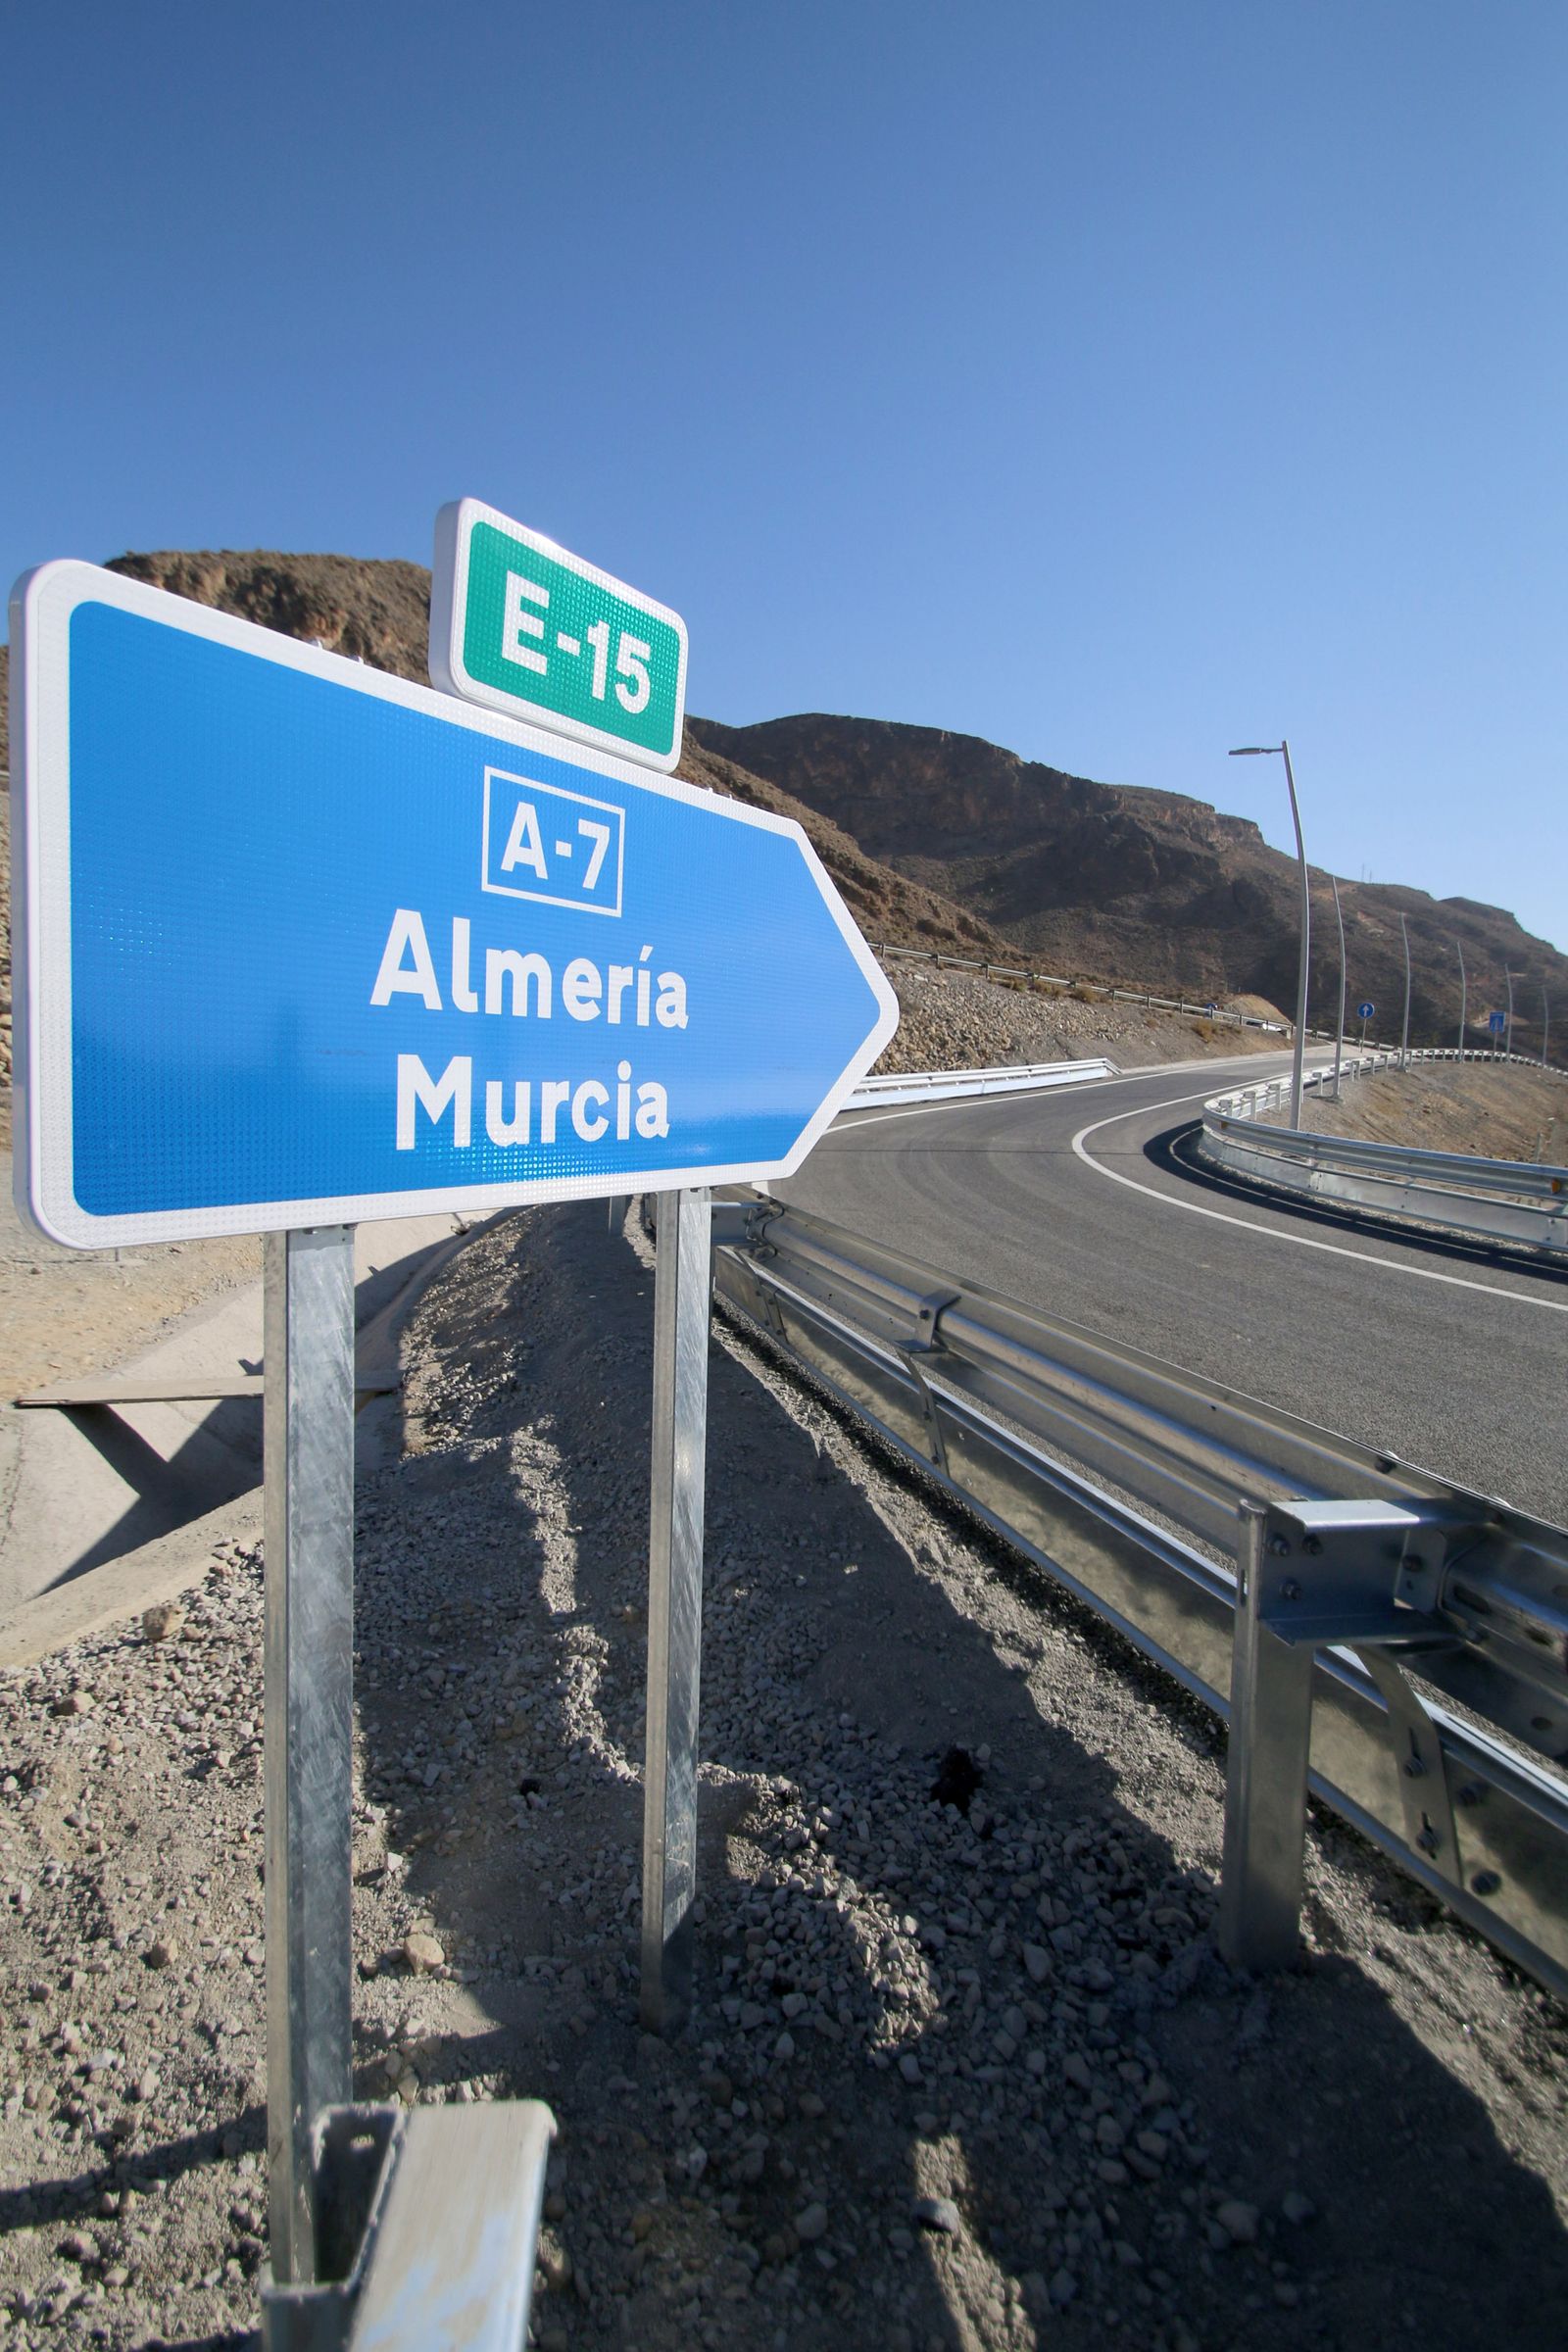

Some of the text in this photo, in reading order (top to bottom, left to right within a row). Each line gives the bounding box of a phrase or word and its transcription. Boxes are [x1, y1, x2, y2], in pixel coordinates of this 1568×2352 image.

[502, 570, 652, 714] E-15
[501, 802, 611, 890] A-7
[369, 908, 688, 1029] Almería
[396, 1054, 669, 1151] Murcia
